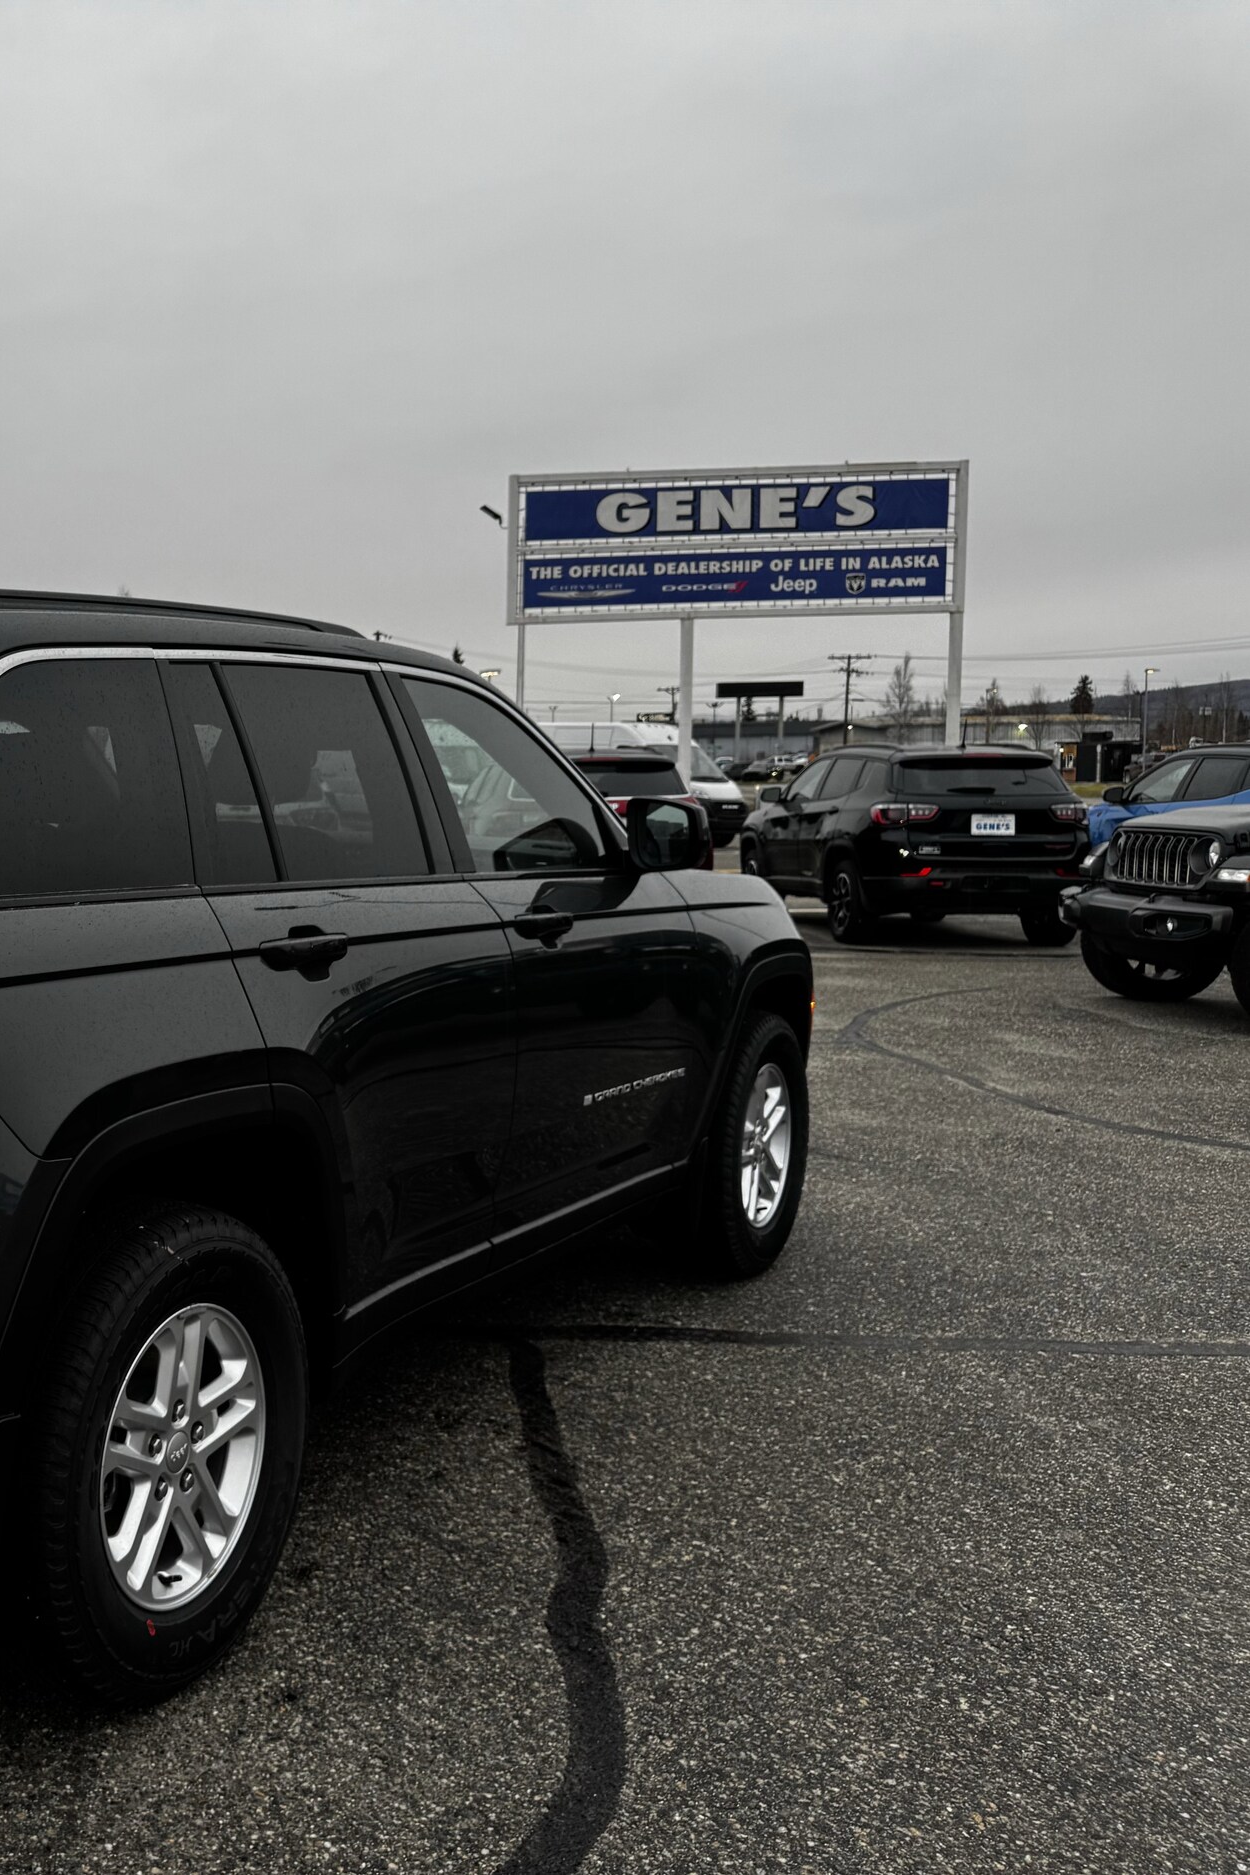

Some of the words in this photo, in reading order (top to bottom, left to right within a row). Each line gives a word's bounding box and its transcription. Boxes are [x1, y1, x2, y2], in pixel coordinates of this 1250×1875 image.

[596, 486, 876, 533] GENE'S
[530, 566, 562, 580] THE
[569, 563, 648, 579] OFFICIAL
[654, 559, 763, 576] DEALERSHIP
[770, 559, 793, 572] OF
[799, 557, 835, 571] LIFE
[841, 557, 861, 570] IN
[867, 554, 940, 570] ALASKA
[549, 583, 624, 591] CHRYSLER
[661, 582, 737, 592] DODGE
[770, 575, 817, 594] Jeep
[871, 577, 926, 588] RAM
[976, 823, 1010, 831] GENE'S
[594, 1083, 631, 1101] GRAND
[632, 1067, 686, 1090] CHEROKEE
